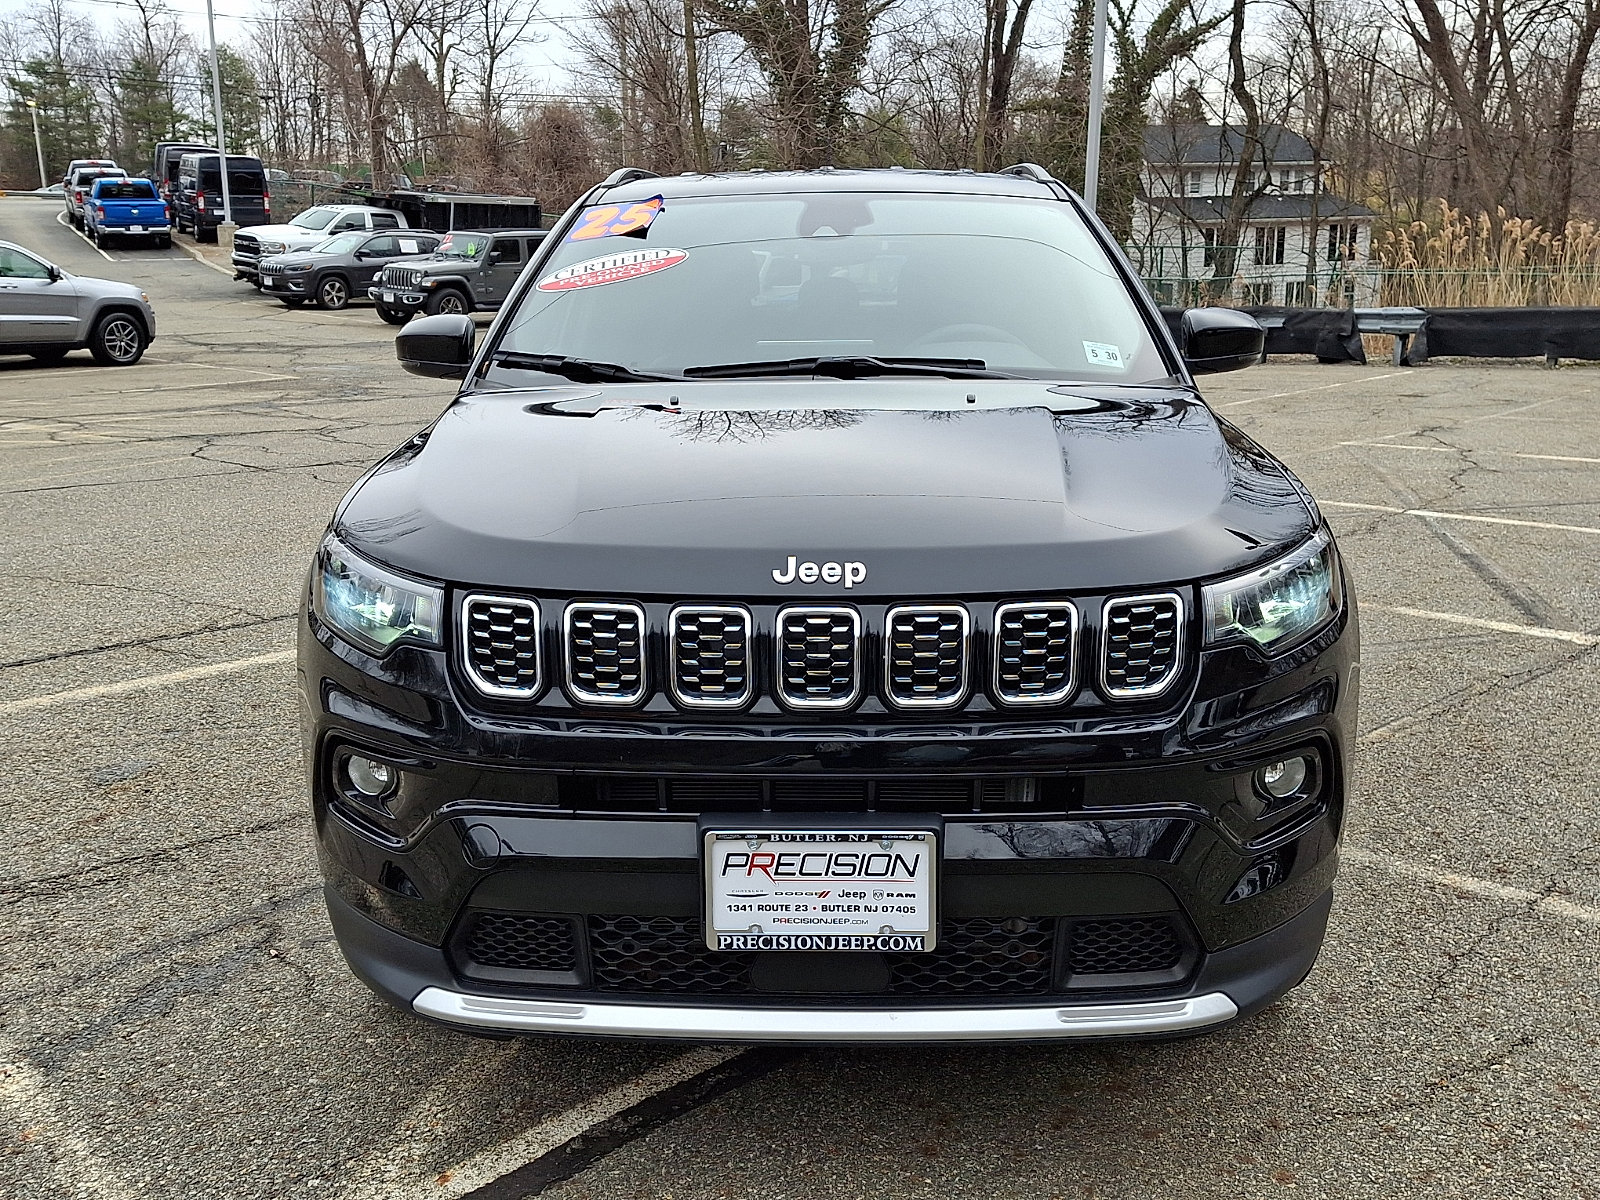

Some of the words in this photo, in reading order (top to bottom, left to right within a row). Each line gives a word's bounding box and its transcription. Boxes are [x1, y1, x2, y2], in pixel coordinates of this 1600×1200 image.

[570, 201, 659, 240] 25
[555, 250, 671, 280] CERTIFIED
[575, 264, 651, 286] VEHICLE
[1091, 348, 1099, 358] 5
[1105, 350, 1118, 361] 30
[771, 555, 868, 589] Jeep
[848, 834, 869, 842] NJ
[721, 852, 921, 882] PRECISION
[837, 889, 867, 900] Jeep
[726, 904, 753, 912] 1341
[757, 904, 792, 912] ROUTE
[794, 904, 809, 912] 23
[821, 904, 861, 913] BUTLER
[863, 905, 879, 913] NJ
[881, 905, 916, 914] 07405
[718, 935, 924, 951] PRECISIONJEEP.COM
